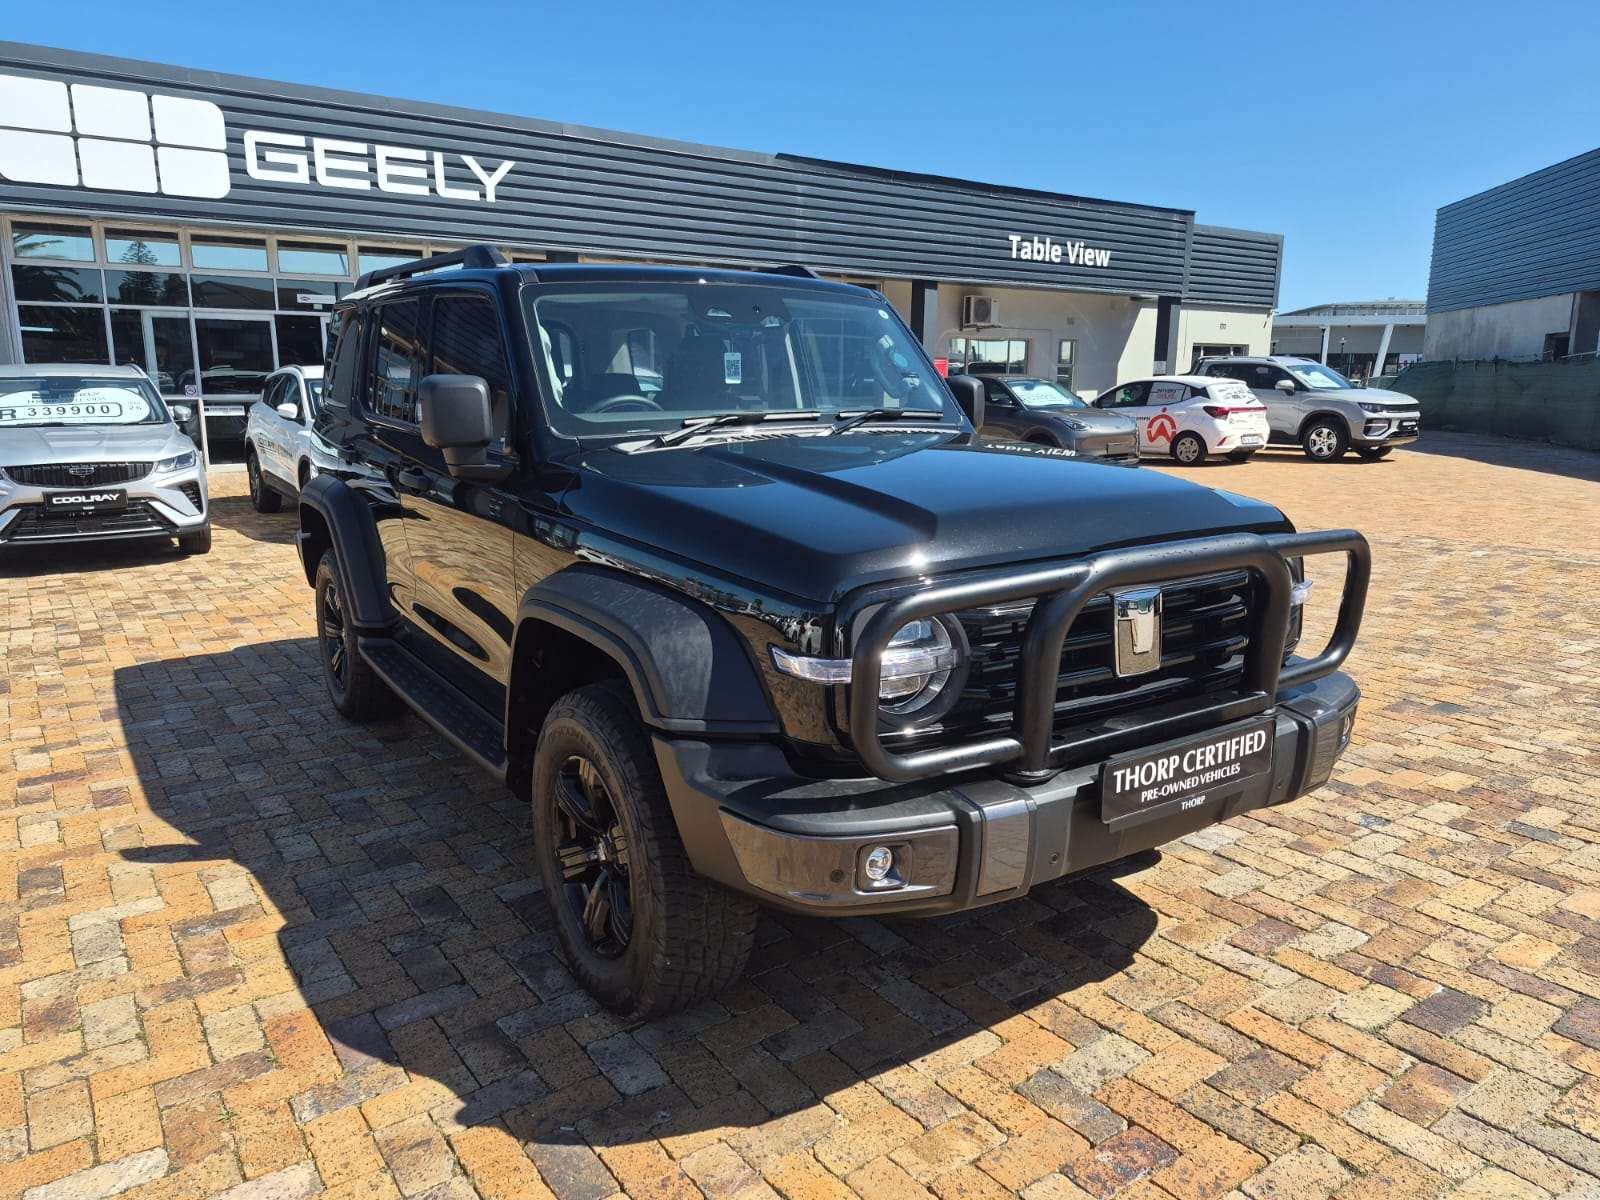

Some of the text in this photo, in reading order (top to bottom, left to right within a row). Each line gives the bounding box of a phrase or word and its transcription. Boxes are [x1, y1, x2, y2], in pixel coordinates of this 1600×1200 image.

[244, 130, 516, 203] GEELY
[1008, 234, 1111, 267] Table View
[27, 404, 110, 417] 339900
[52, 492, 120, 505] COOLRAY
[1113, 729, 1266, 794] THORP CERTIFIED
[1141, 762, 1241, 803] PRE-OWNED VEHICLES
[1181, 795, 1206, 811] THORP
